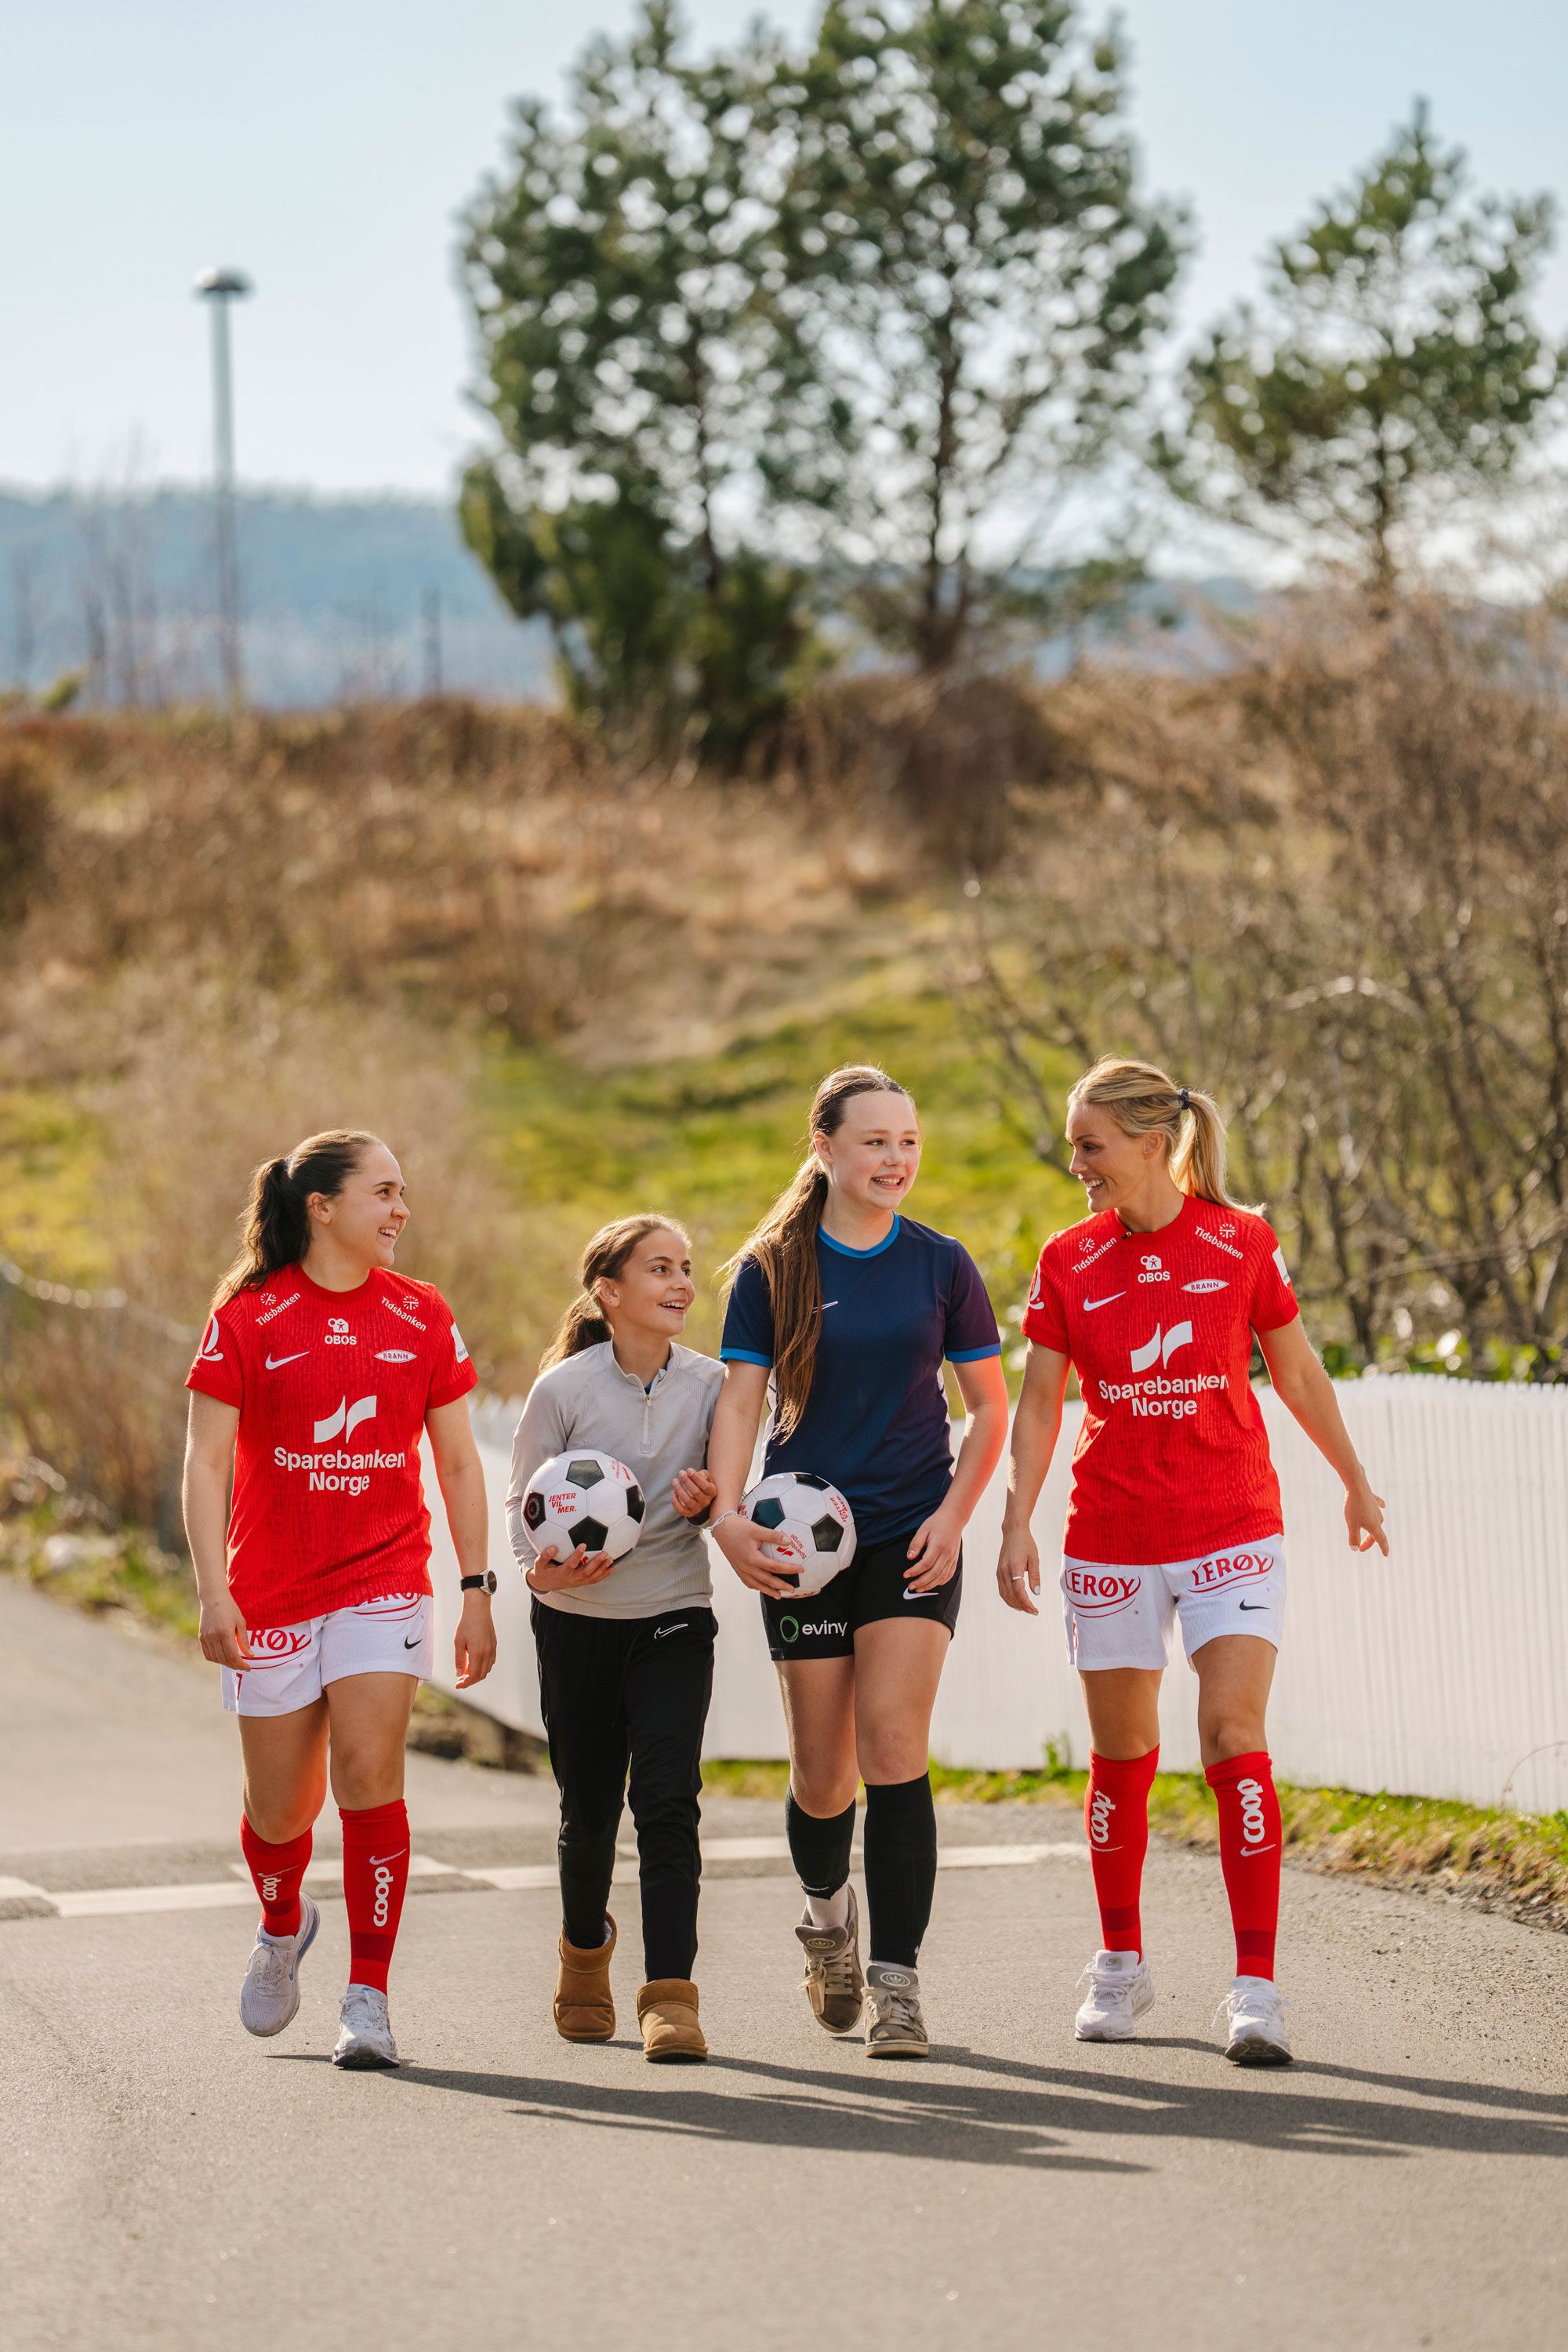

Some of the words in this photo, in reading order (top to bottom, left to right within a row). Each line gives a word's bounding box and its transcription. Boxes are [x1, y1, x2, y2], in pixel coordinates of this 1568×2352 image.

[1071, 1236, 1117, 1275] Tidsbanken
[1195, 1226, 1243, 1260] Tidsbanken
[1138, 1270, 1171, 1283] OBOS
[1190, 1282, 1220, 1291] BRANN
[256, 1292, 301, 1326] Tidsbanken
[380, 1296, 426, 1332] Tidsbanken
[324, 1334, 358, 1345] OBOS
[383, 1352, 408, 1361] BRANN
[1099, 1374, 1229, 1403] Sparebanken
[1131, 1398, 1198, 1420] Norge
[274, 1446, 405, 1472] Sparebanken
[308, 1472, 370, 1497] Norge
[548, 1492, 577, 1503] JENTER
[557, 1504, 577, 1514] MER.
[790, 1534, 804, 1549] Norge
[1191, 1554, 1269, 1587] LERØY
[1064, 1569, 1135, 1599] LERØY
[801, 1621, 848, 1638] eviny
[1236, 1778, 1265, 1844] coop
[374, 1866, 394, 1927] coop
